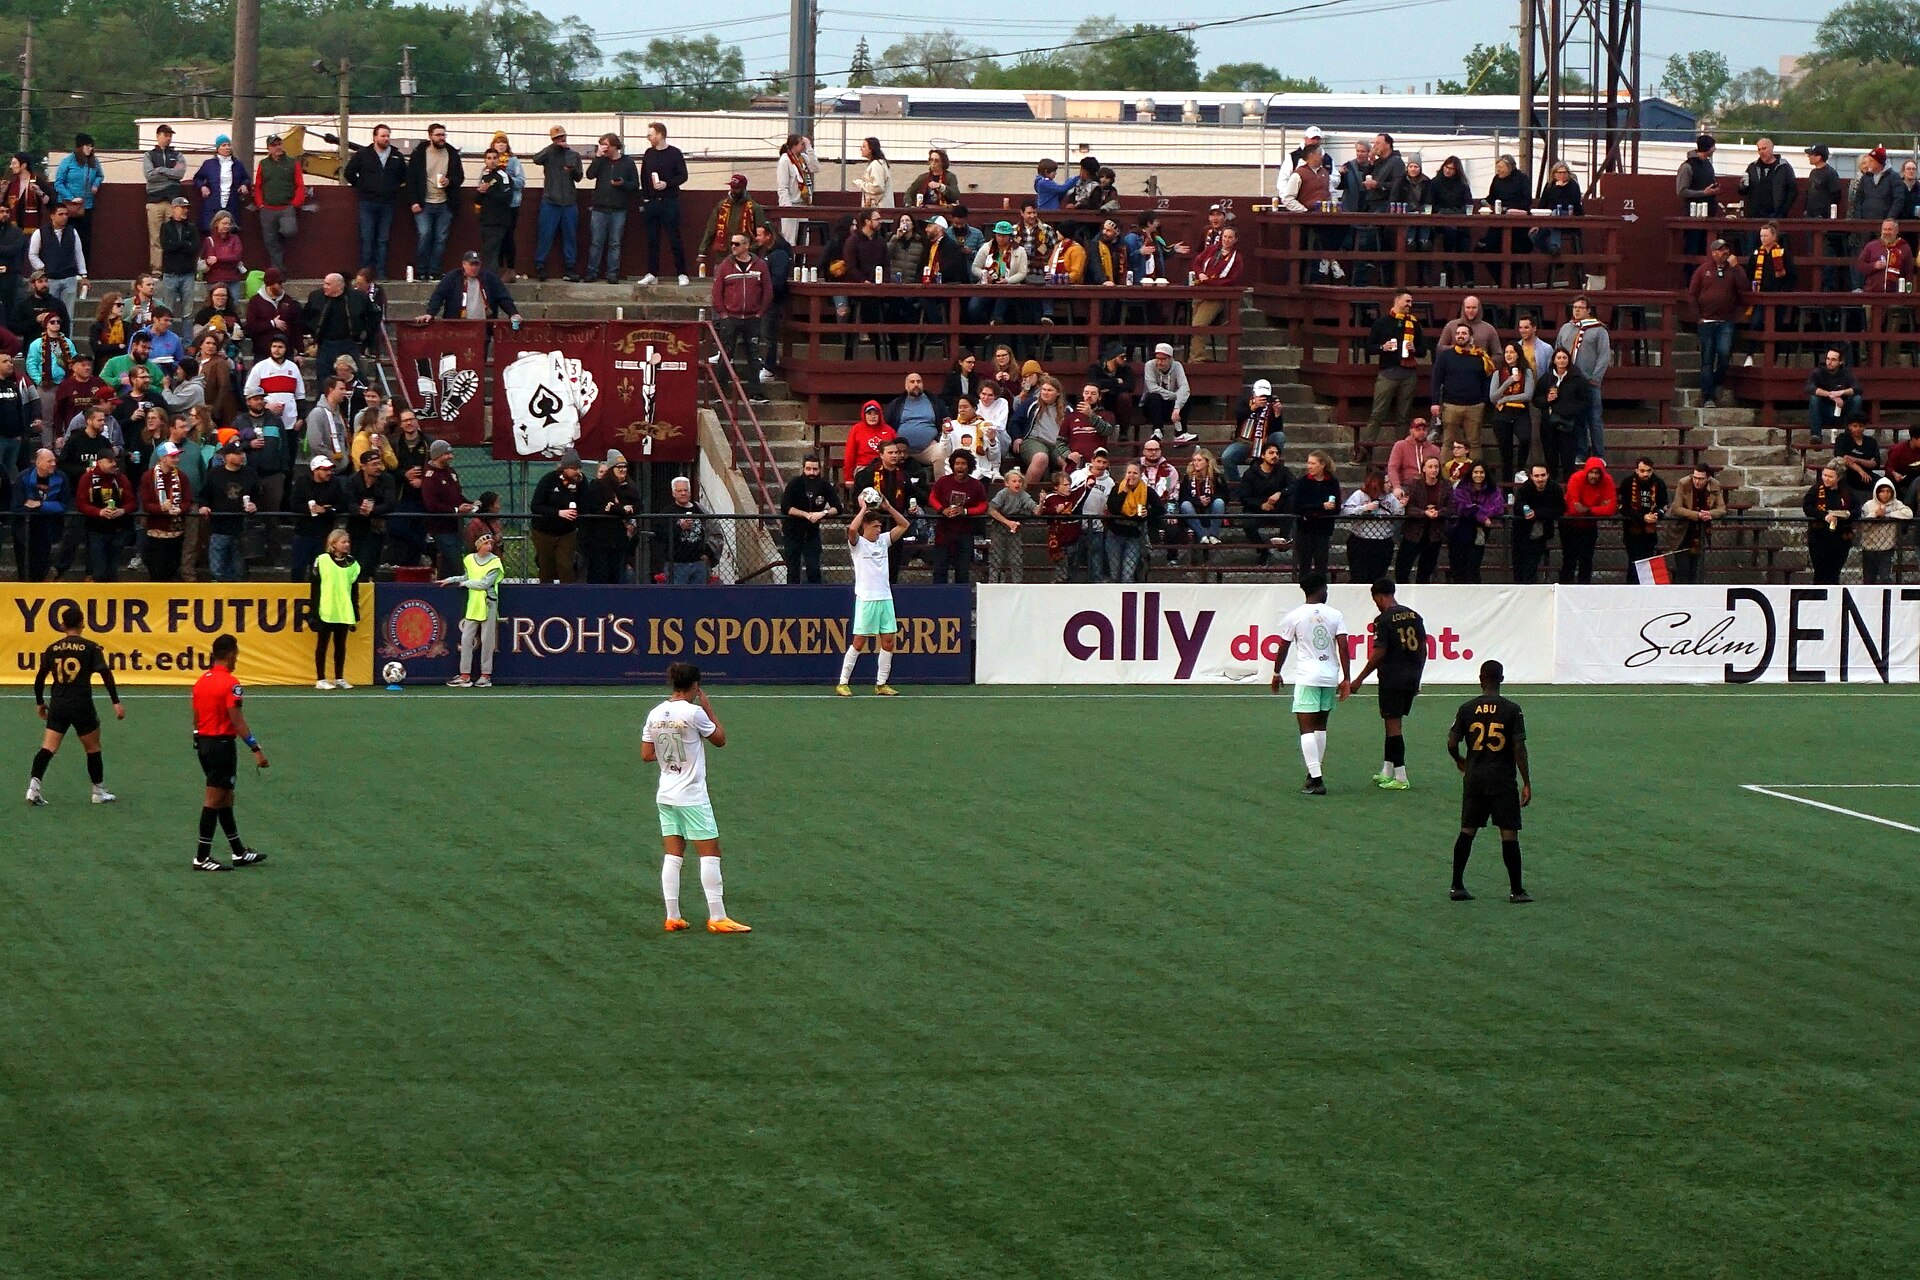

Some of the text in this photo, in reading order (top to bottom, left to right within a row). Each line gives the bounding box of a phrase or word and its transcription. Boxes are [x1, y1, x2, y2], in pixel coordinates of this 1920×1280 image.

[1220, 199, 1233, 209] 22
[1623, 199, 1635, 210] 21
[555, 358, 562, 371] A
[571, 363, 577, 375] 3
[581, 376, 588, 387] A
[587, 388, 595, 399] 2
[168, 598, 322, 633] FUTUR
[457, 613, 635, 657] ROH'S
[648, 617, 684, 655] IS
[695, 617, 848, 655] SPOKEN
[1063, 591, 1216, 680] ally
[1230, 623, 1474, 661] do rit.
[1312, 625, 1330, 650] 8
[1397, 626, 1419, 651] 18
[1624, 612, 1760, 668] Salim
[54, 657, 81, 684] 19
[1474, 704, 1497, 715] ABU
[658, 733, 687, 762] 21
[1469, 722, 1506, 752] 25
